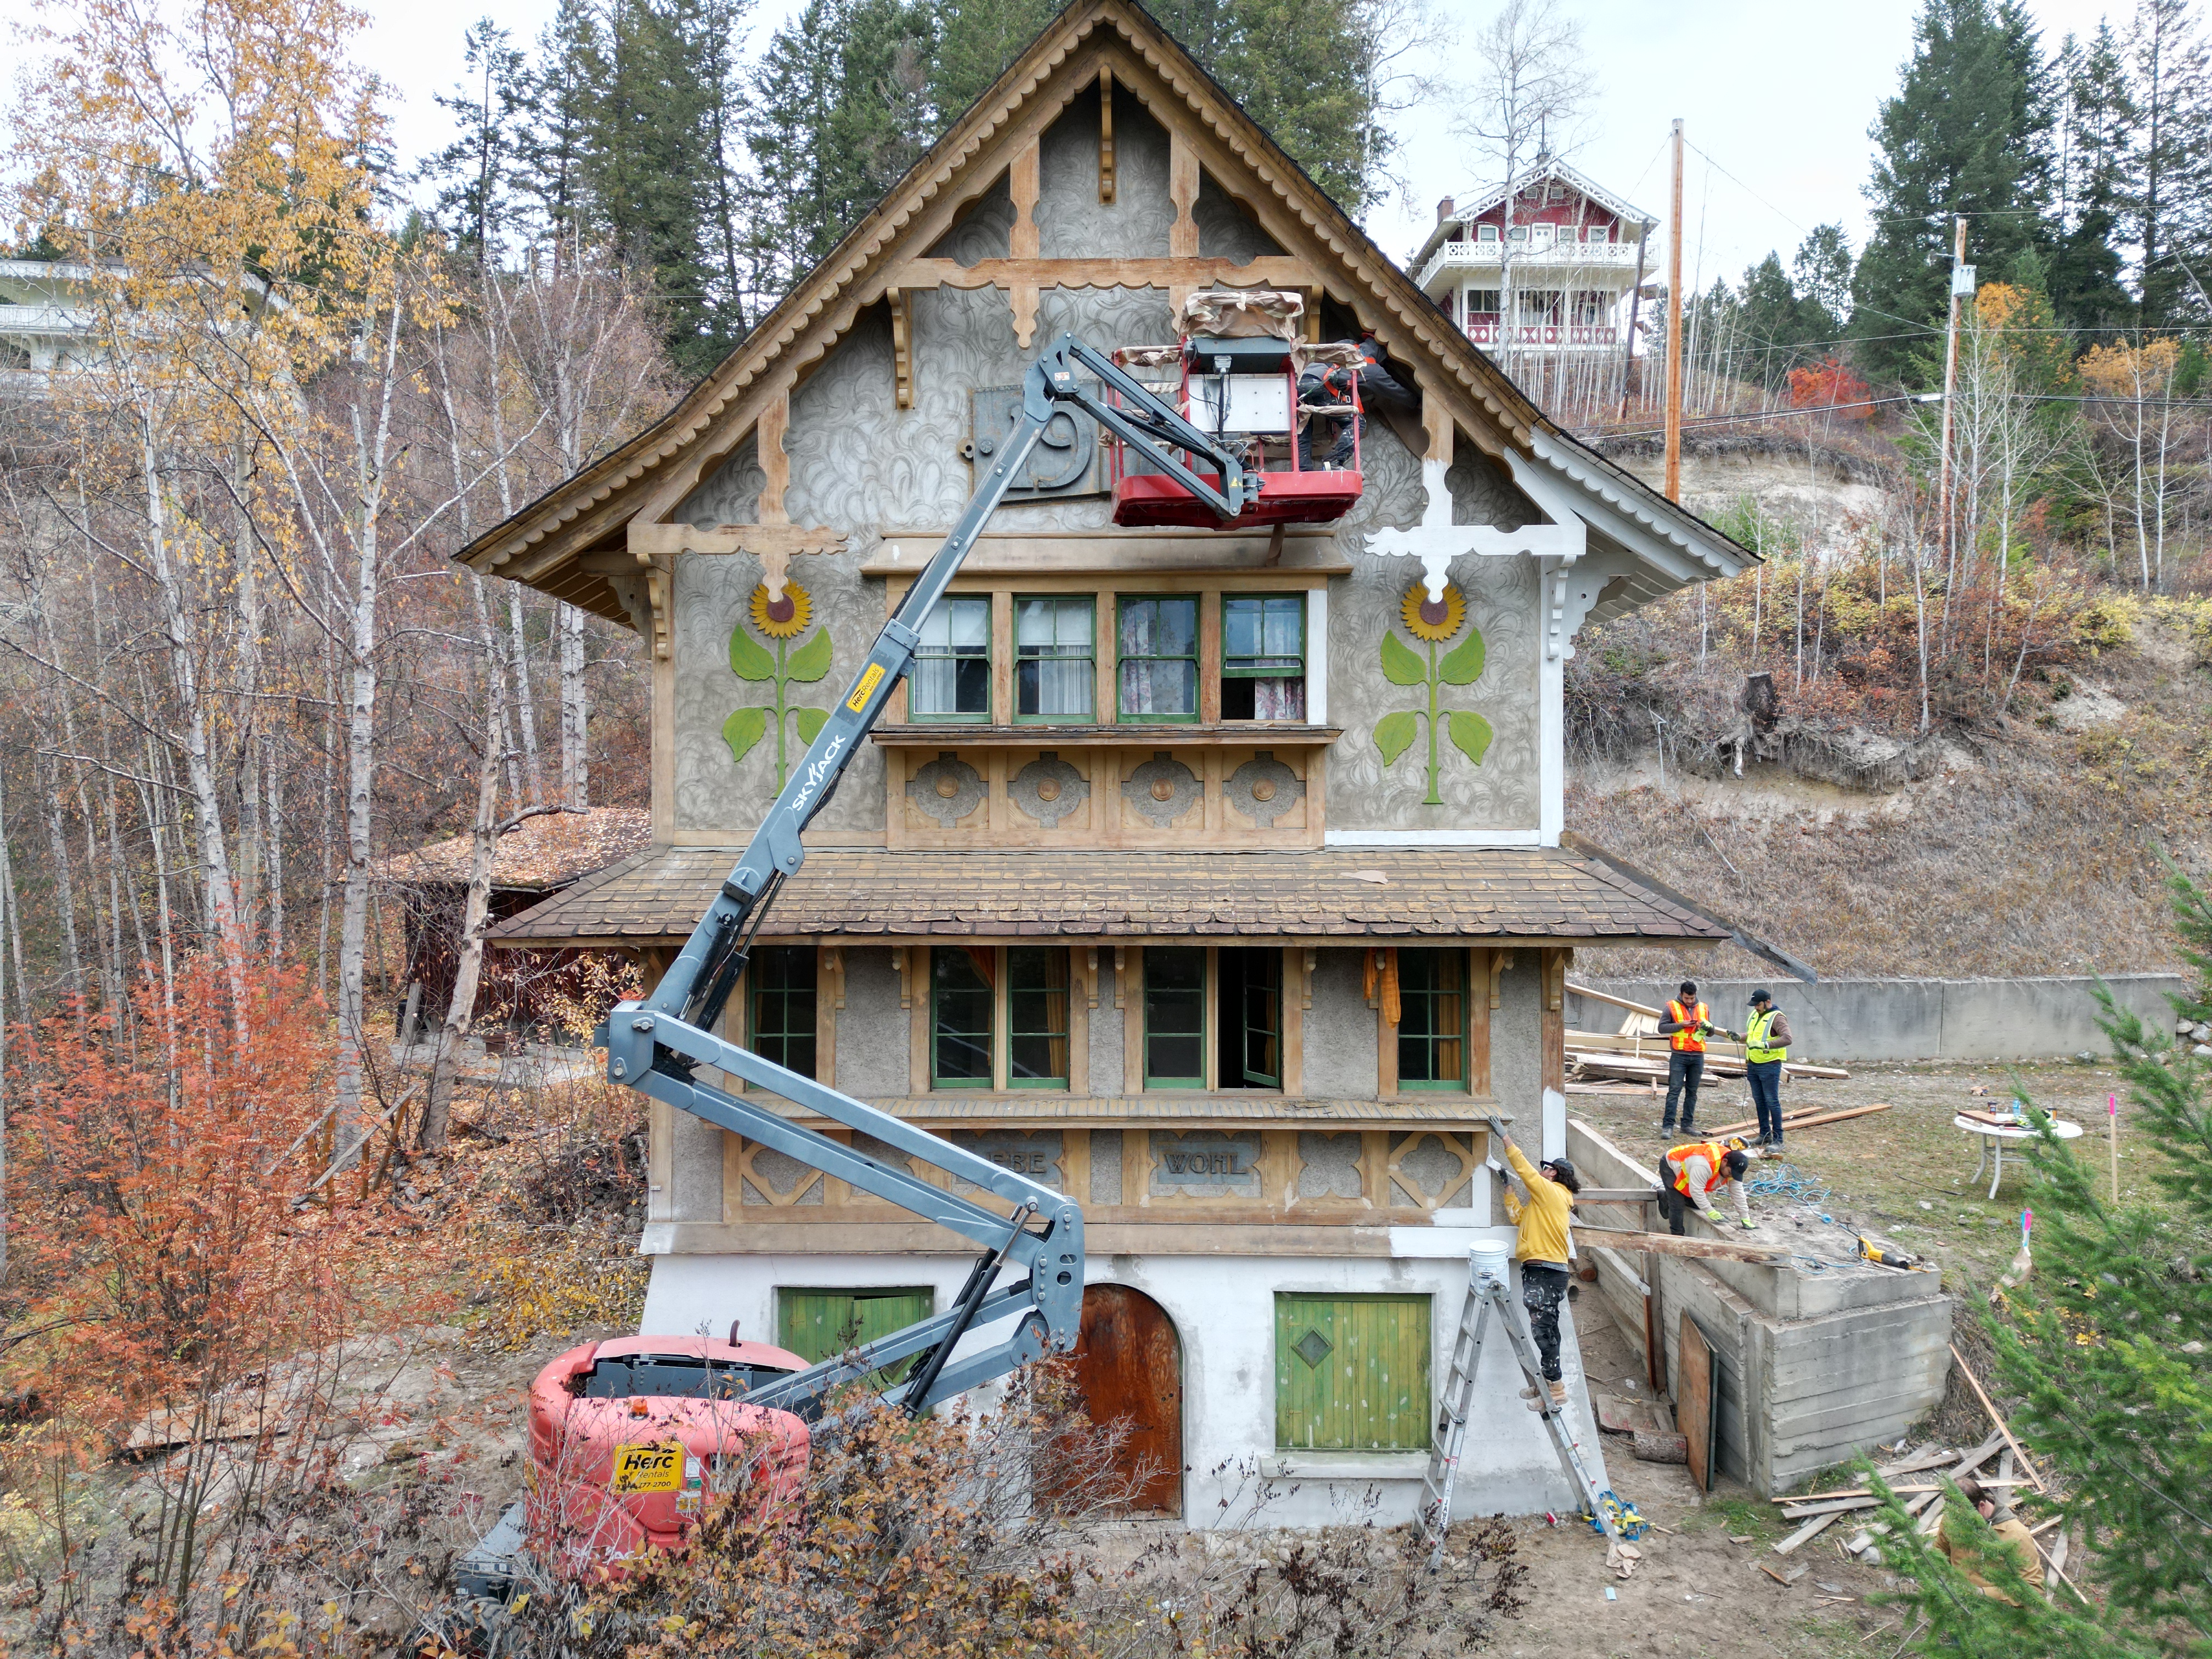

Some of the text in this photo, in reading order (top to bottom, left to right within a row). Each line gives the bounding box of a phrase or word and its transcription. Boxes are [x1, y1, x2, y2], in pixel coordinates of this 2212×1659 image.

[792, 735, 846, 811] SKYJACK
[1164, 1153, 1247, 1173] WOHL
[624, 1454, 674, 1470] Herc
[637, 1470, 670, 1479] Rentals
